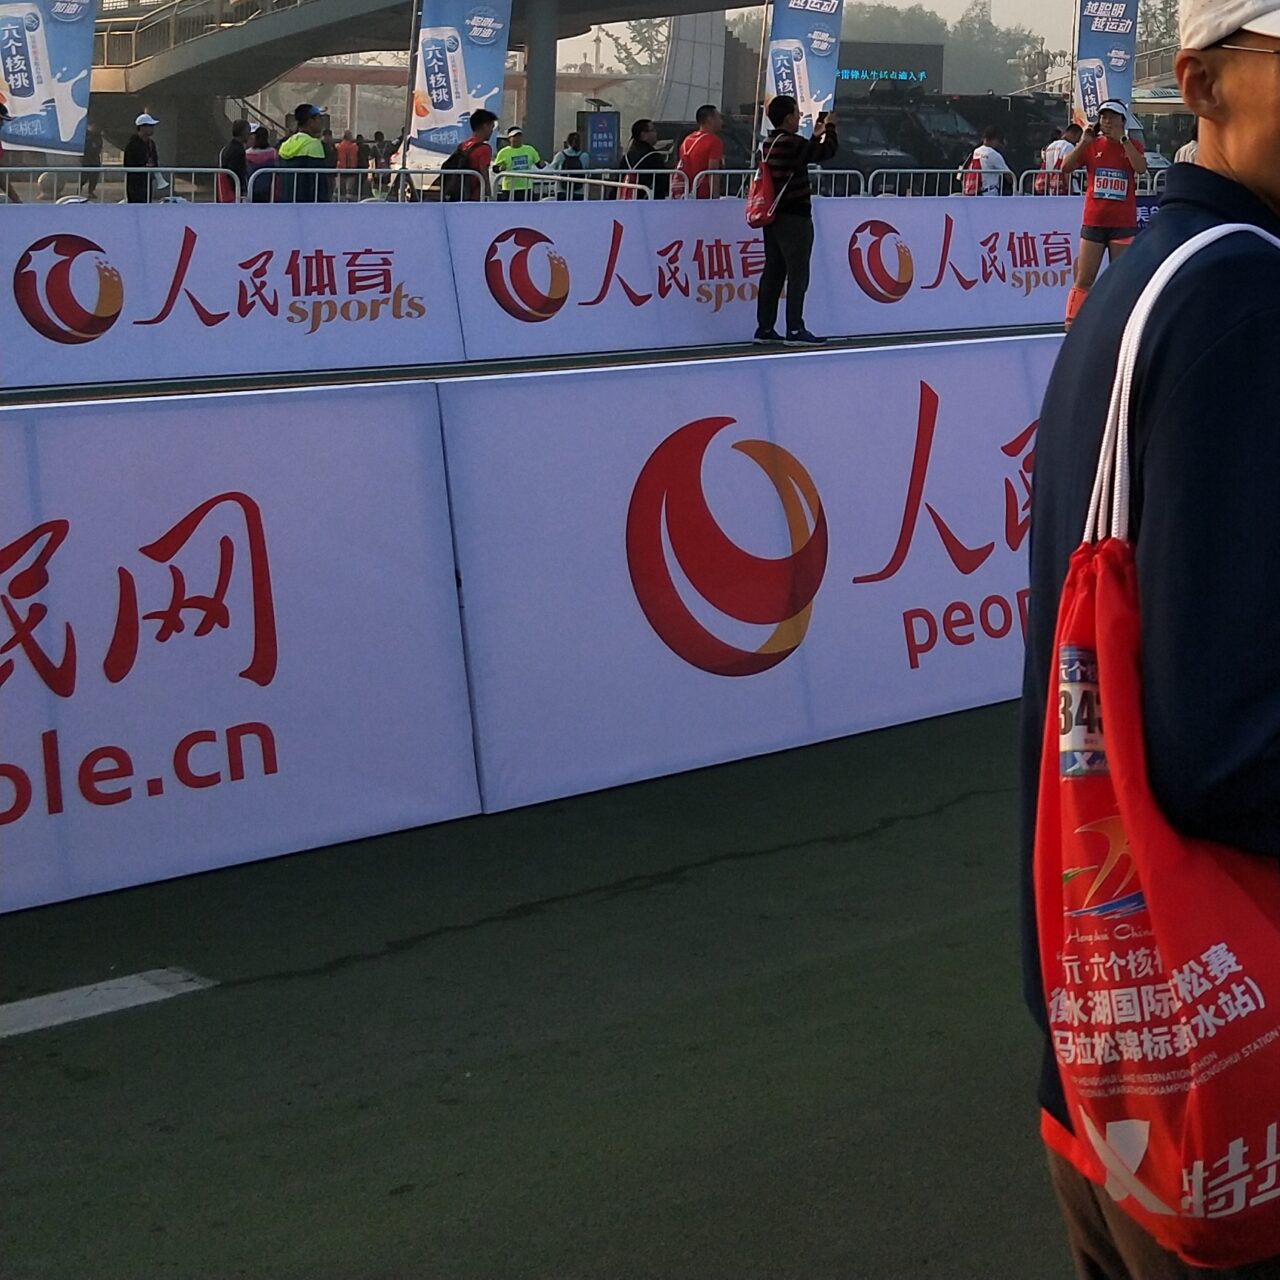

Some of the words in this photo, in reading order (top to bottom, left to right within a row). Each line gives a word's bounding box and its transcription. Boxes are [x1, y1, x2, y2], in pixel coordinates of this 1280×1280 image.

[1083, 0, 1127, 18] 越聪明
[1091, 16, 1133, 34] 越运动
[1, 23, 30, 89] 六个核桃
[425, 45, 449, 104] 六个核桃
[132, 225, 395, 327] 人民体育
[920, 213, 1072, 290] 人民体育
[695, 282, 760, 313] spo
[1011, 257, 1079, 297] spor
[286, 281, 427, 335] sports
[1059, 689, 1104, 736] 34
